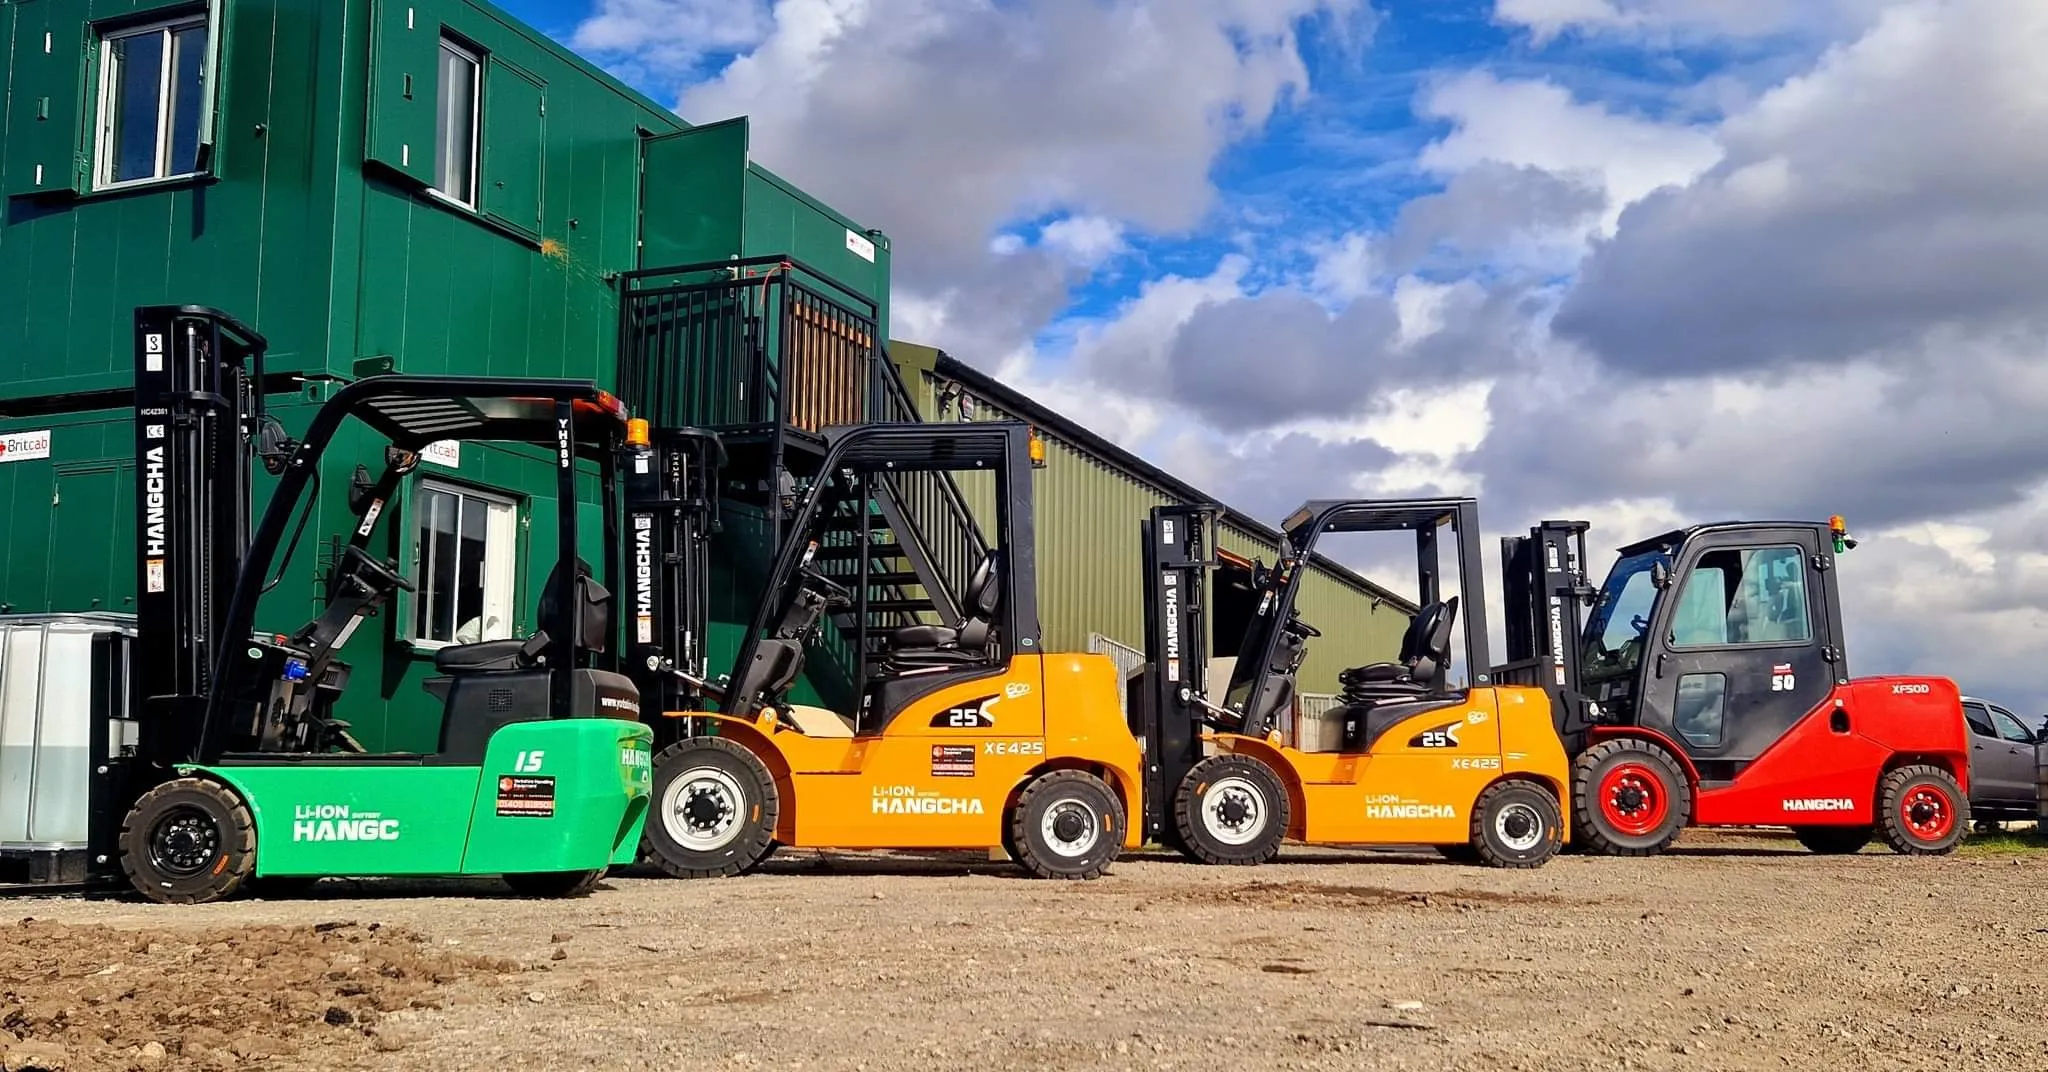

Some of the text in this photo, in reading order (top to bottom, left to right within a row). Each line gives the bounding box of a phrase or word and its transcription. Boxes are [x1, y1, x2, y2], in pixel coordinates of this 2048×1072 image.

[146, 446, 165, 556] HANGCHA
[636, 529, 652, 617] HANGCHA
[1166, 588, 1179, 658] HANGCHA
[1550, 606, 1564, 665] HANGCHA
[1772, 674, 1795, 691] 50
[1891, 684, 1930, 695] XF50D
[949, 708, 978, 727] 25
[1422, 731, 1447, 747] 25
[984, 741, 1044, 755] XE425
[1452, 758, 1500, 769] XE425
[872, 798, 984, 814] HANGCHA
[1366, 804, 1456, 818] HANGCHA
[1783, 799, 1855, 811] HANGCHA
[293, 820, 400, 841] HANGC
